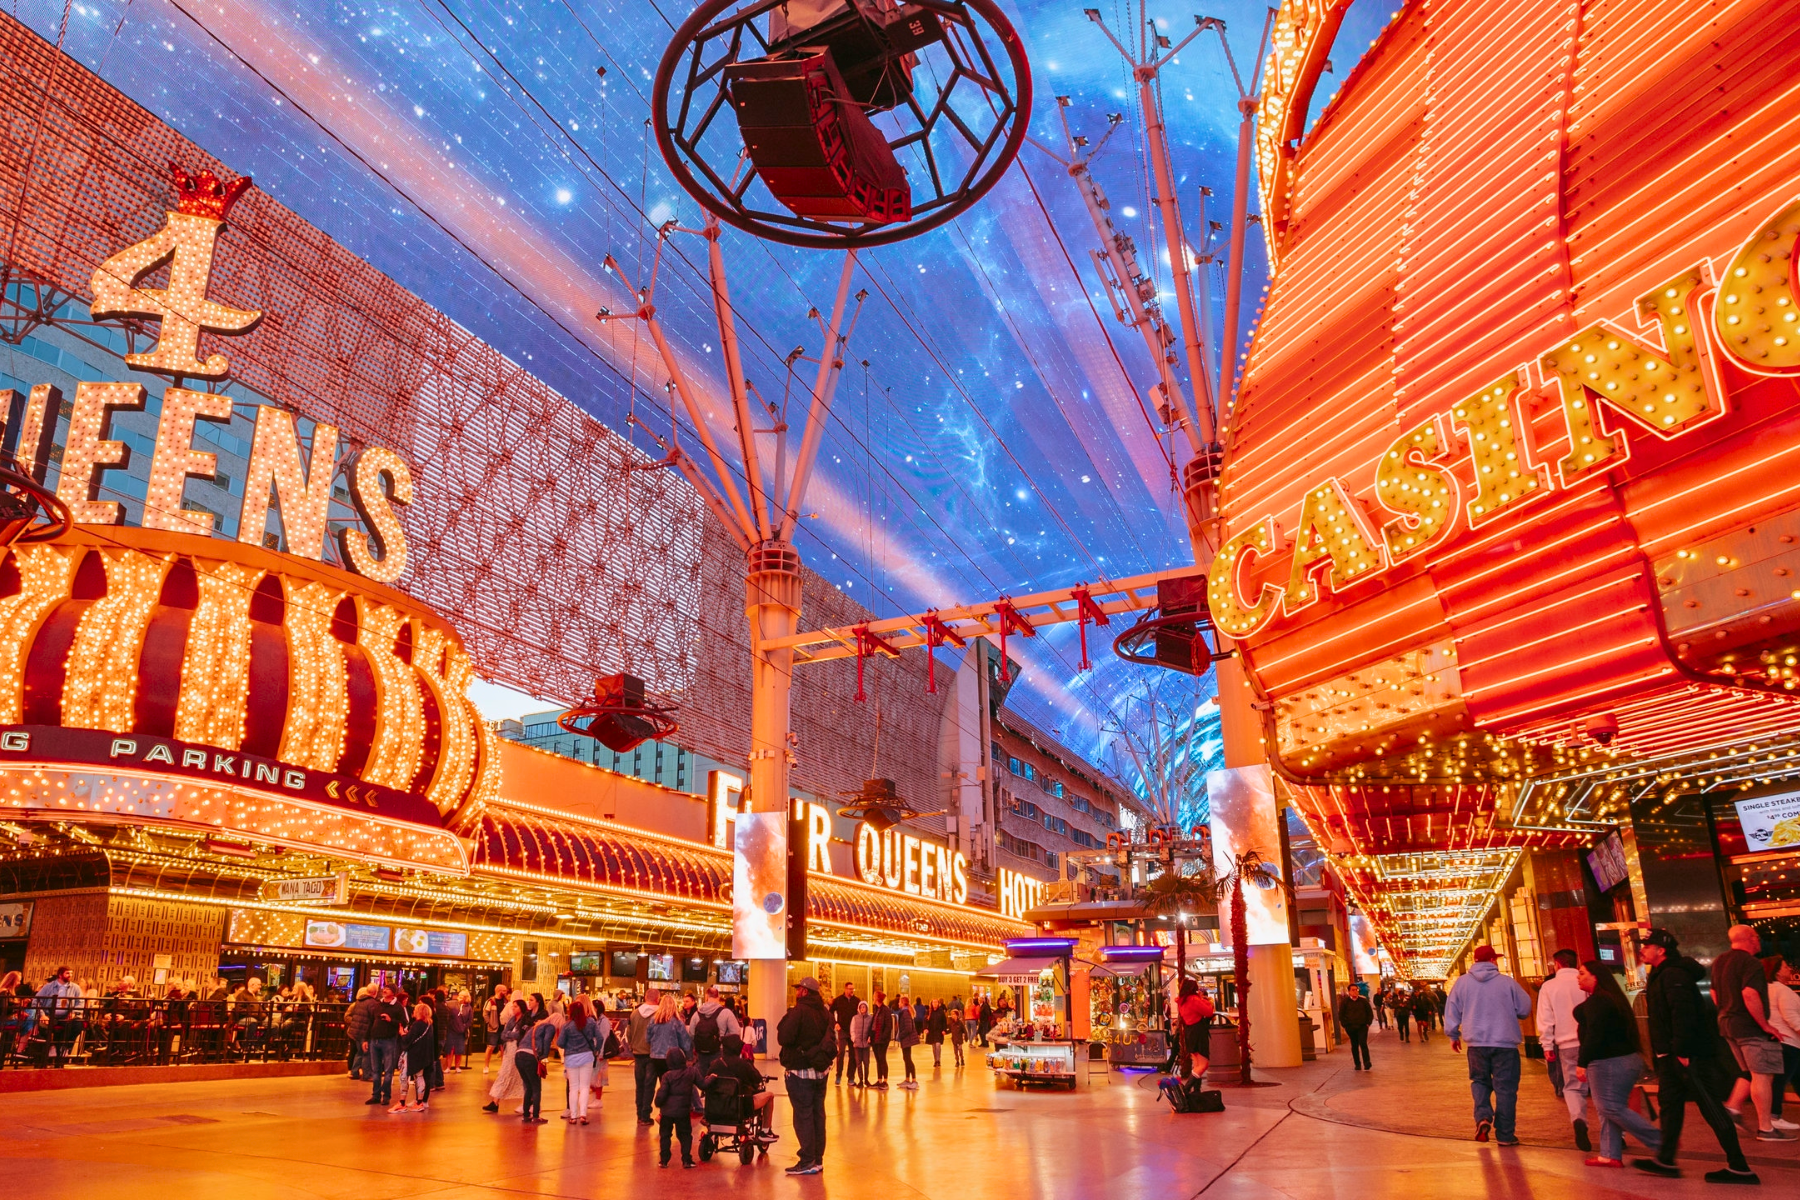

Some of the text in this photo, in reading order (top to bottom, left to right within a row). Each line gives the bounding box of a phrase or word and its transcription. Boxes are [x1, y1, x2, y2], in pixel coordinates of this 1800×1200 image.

[90, 211, 265, 382] 4
[110, 739, 306, 790] PARKING
[1743, 802, 1770, 811] SINGLE
[708, 770, 832, 875] FR
[853, 820, 968, 904] QUEENS
